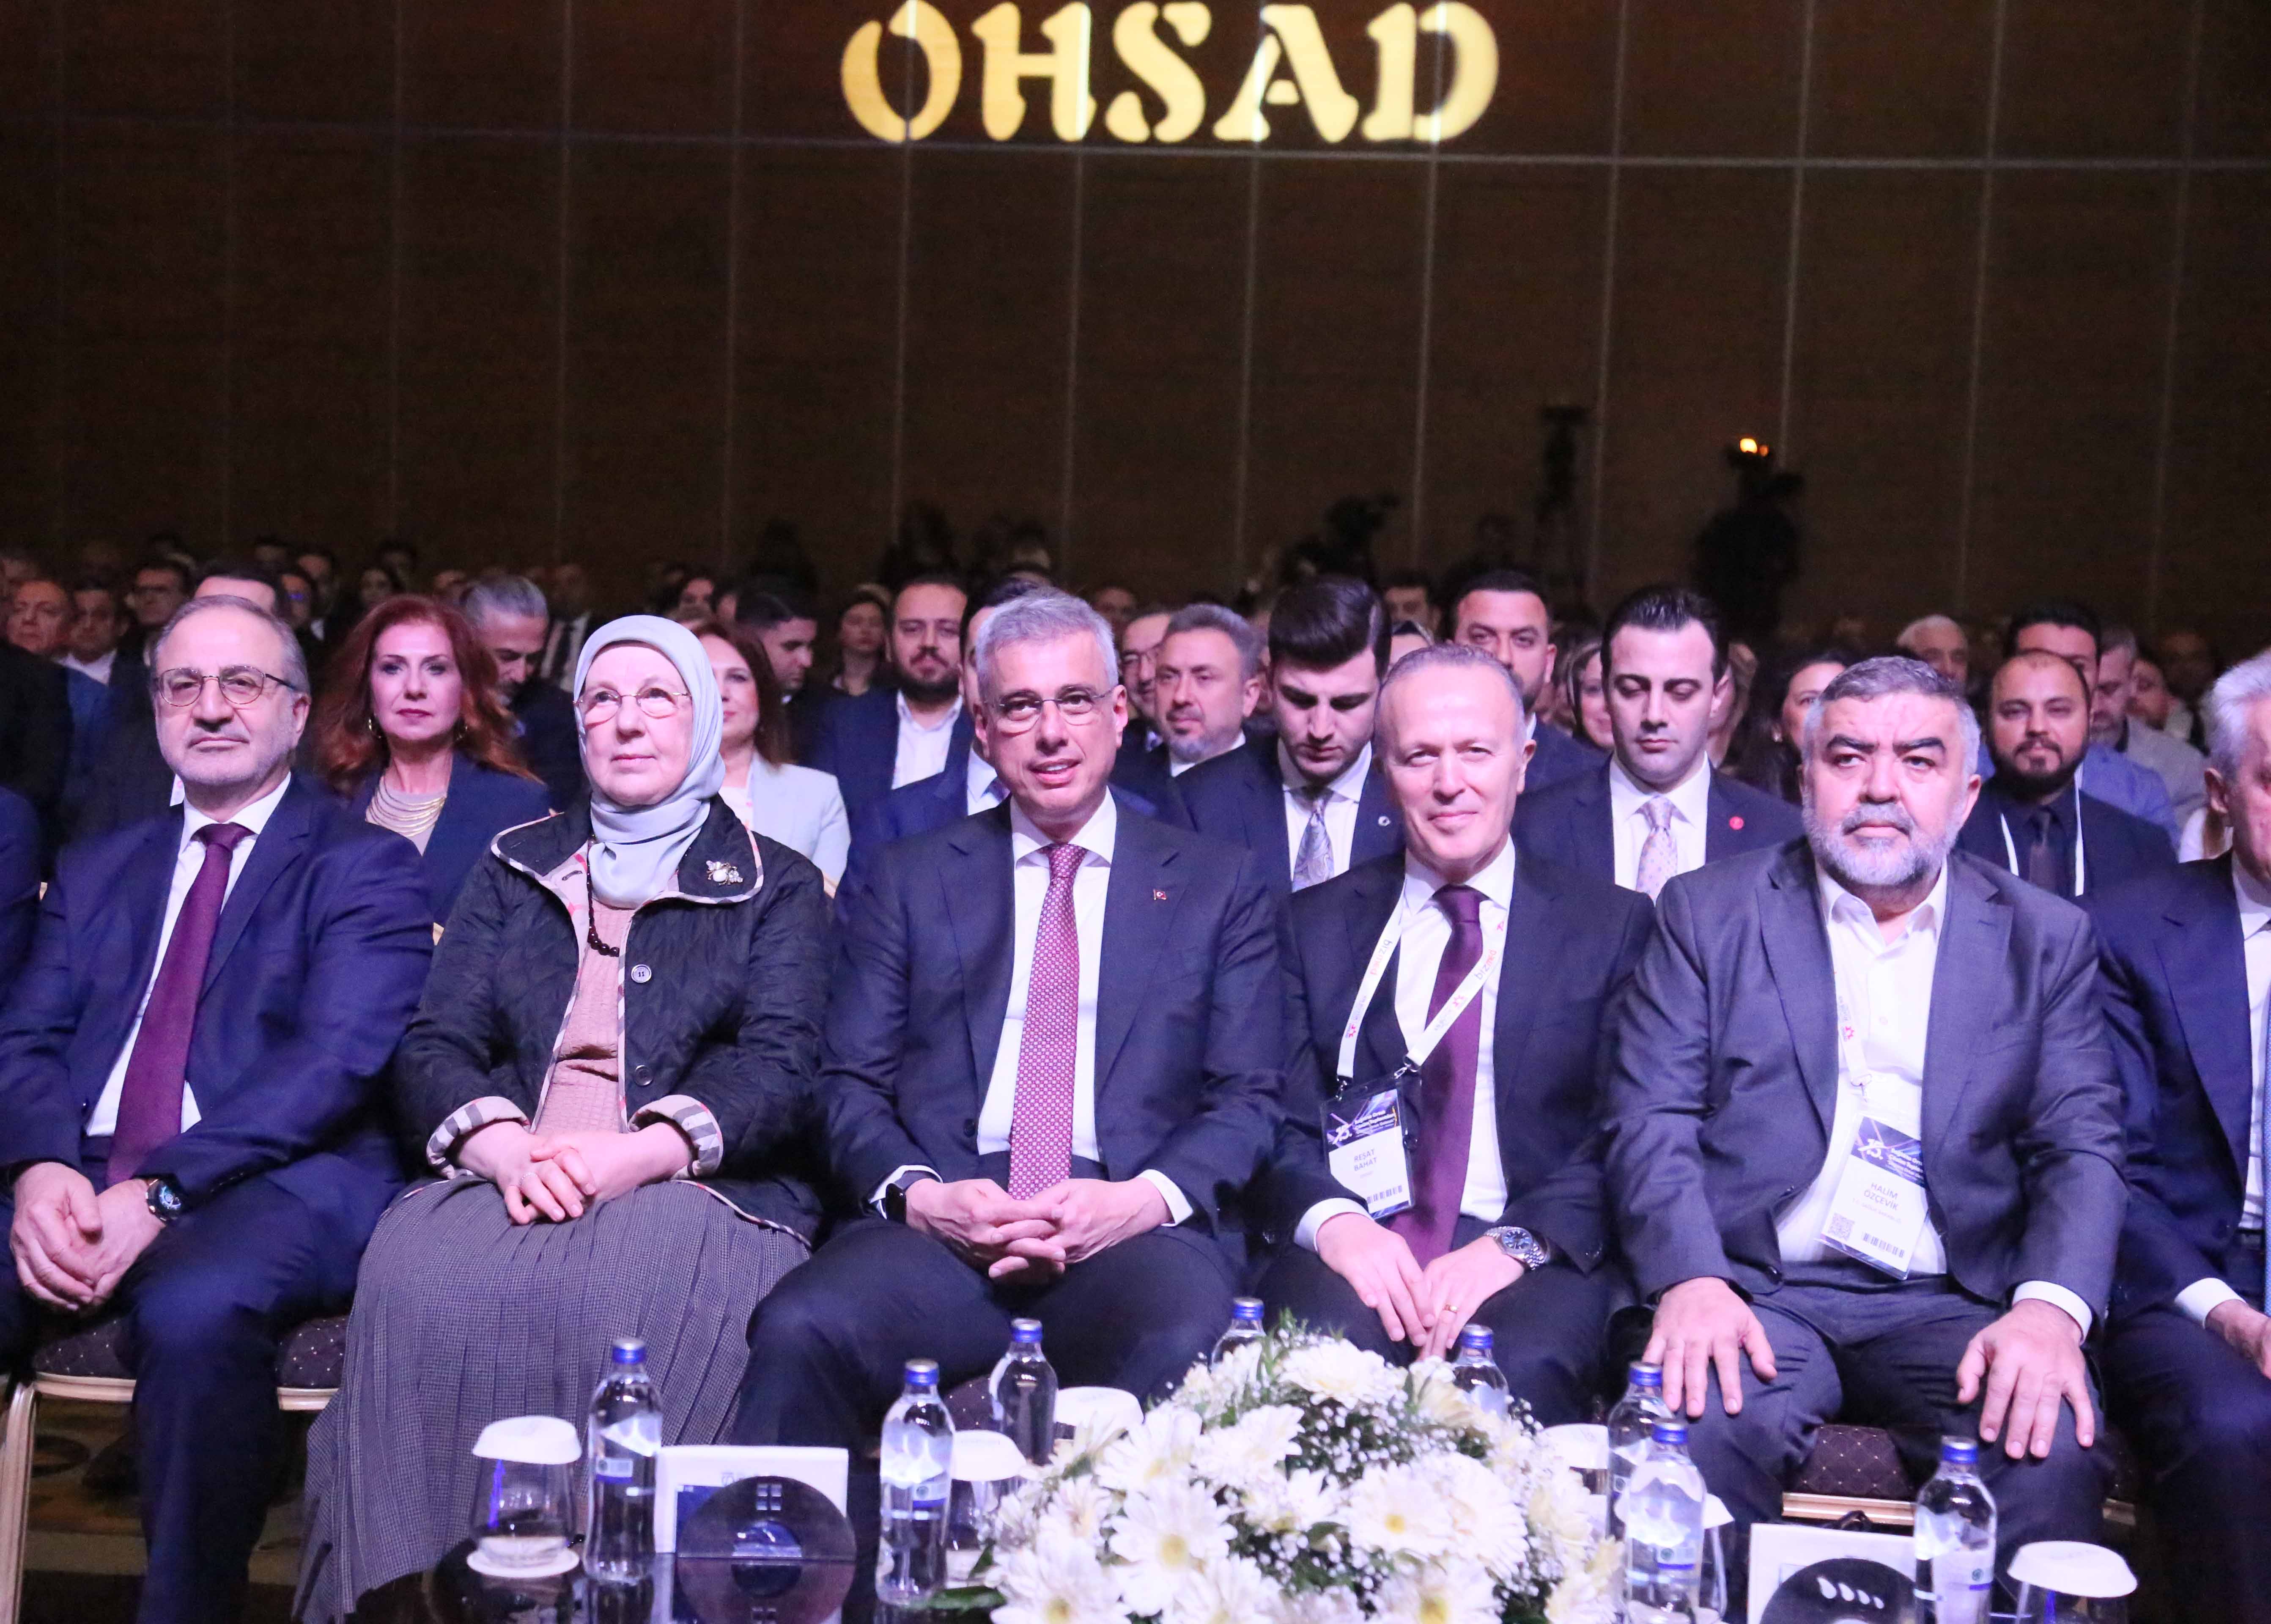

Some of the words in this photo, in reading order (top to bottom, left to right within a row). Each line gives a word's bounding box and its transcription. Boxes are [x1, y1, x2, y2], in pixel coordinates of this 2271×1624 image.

[841, 0, 1499, 143] OHSAD
[1369, 939, 1393, 975] bizmed
[1474, 949, 1497, 980] bizmed
[1354, 1157, 1377, 1171] BAHAT
